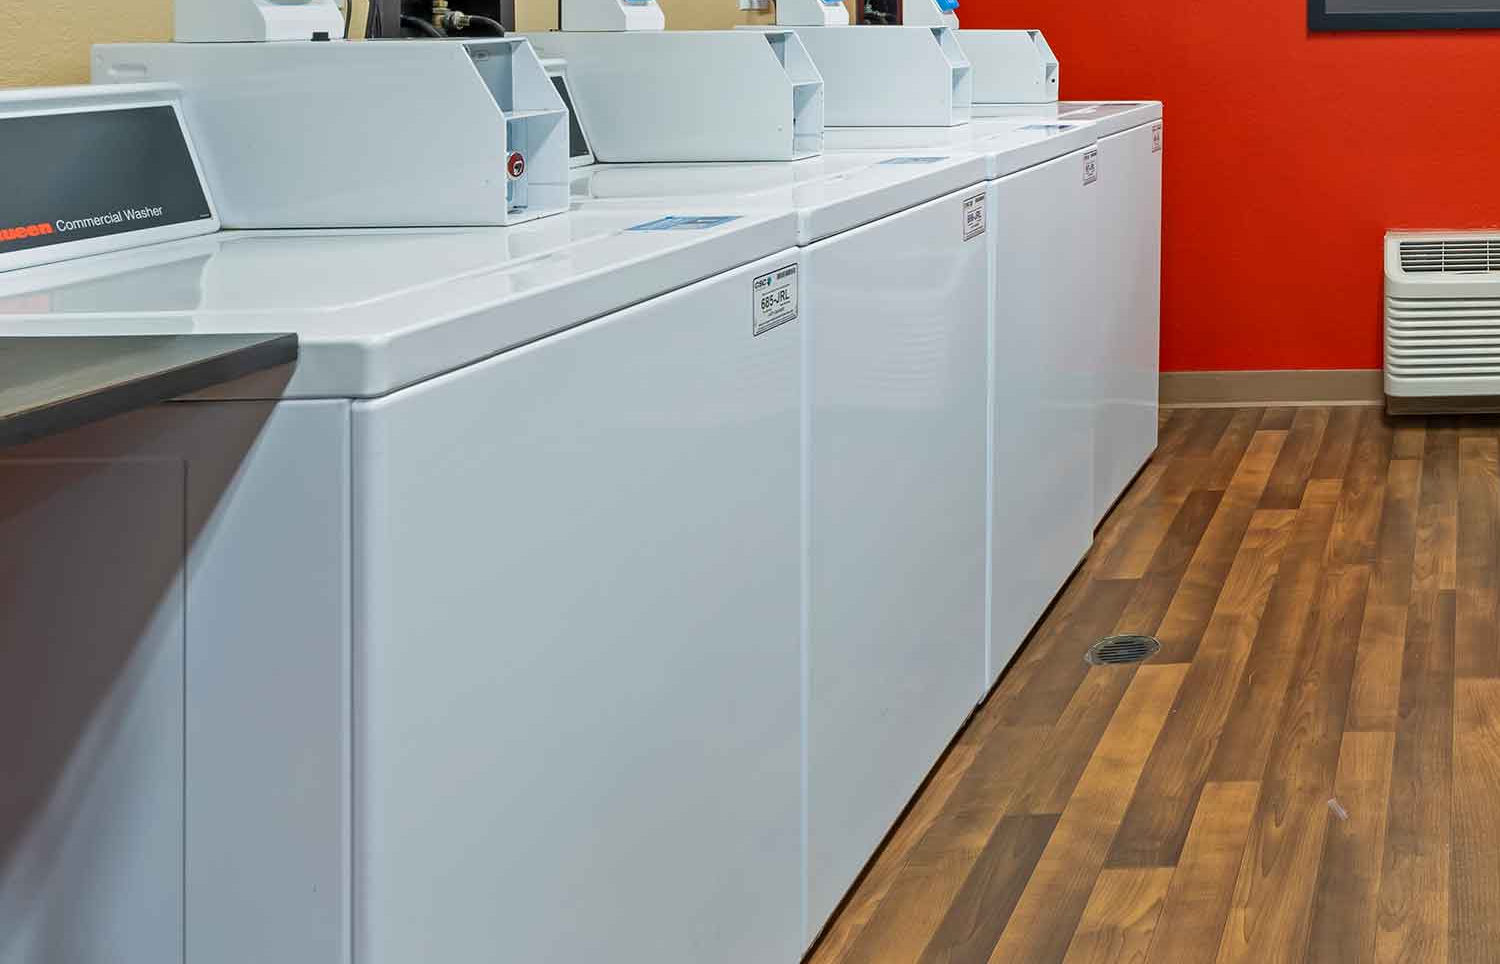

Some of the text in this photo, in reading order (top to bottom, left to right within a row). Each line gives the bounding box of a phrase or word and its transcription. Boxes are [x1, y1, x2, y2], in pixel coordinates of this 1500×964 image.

[0, 205, 164, 242] ueen Commercial Washer
